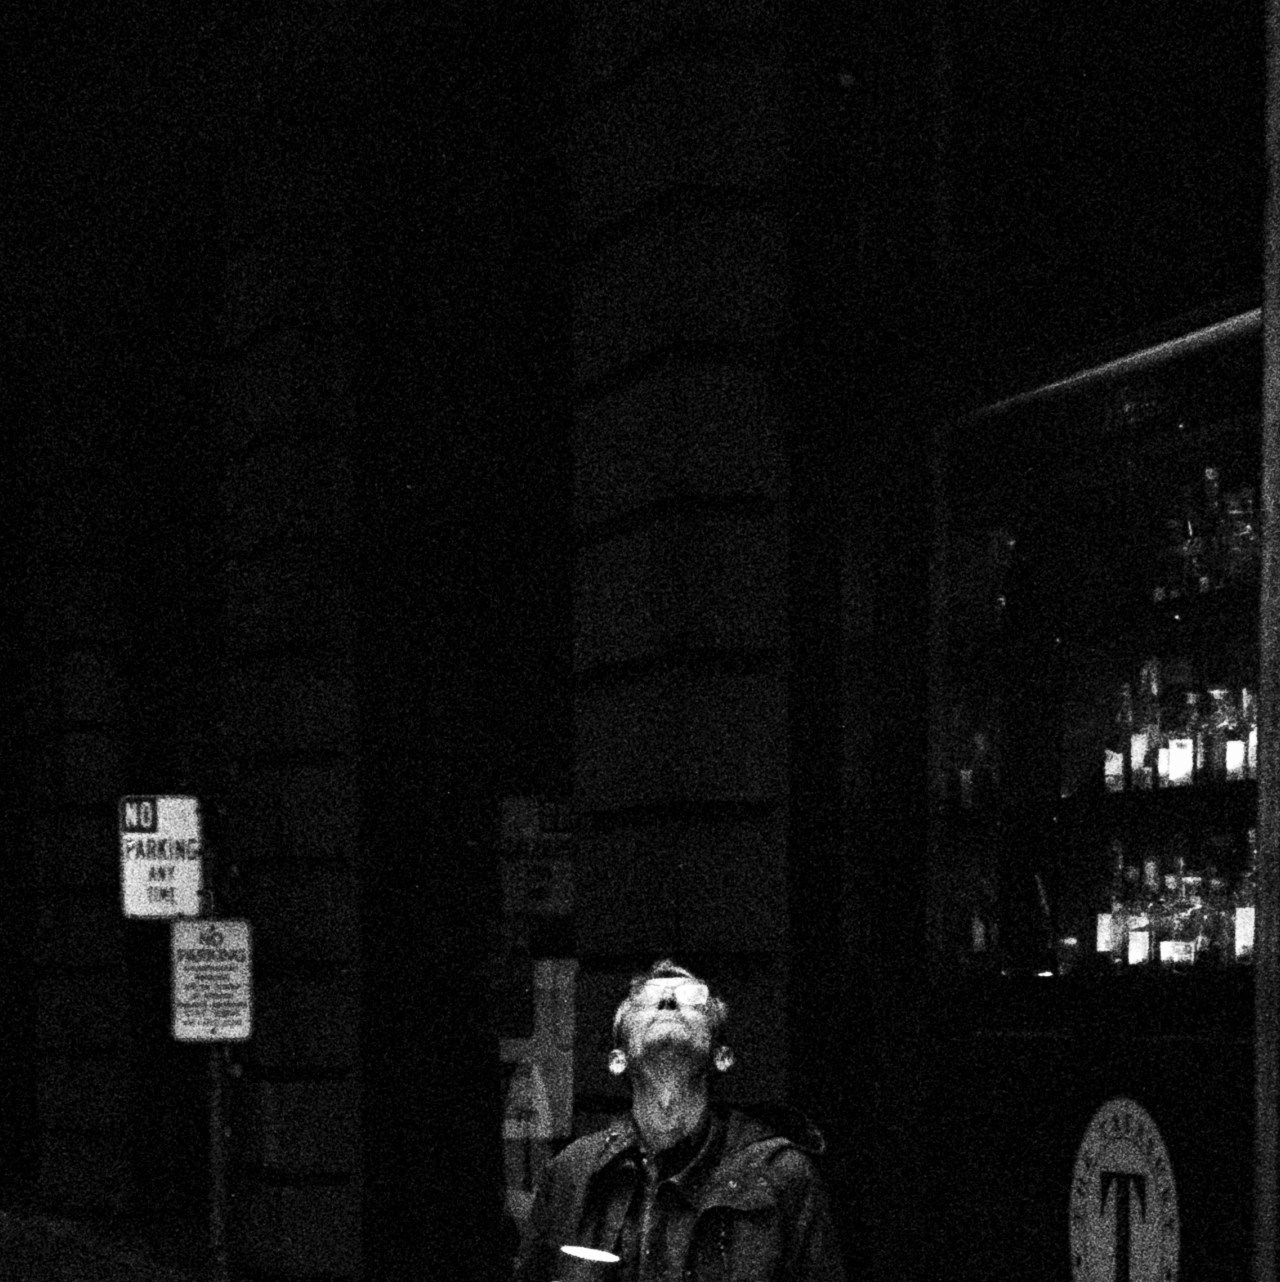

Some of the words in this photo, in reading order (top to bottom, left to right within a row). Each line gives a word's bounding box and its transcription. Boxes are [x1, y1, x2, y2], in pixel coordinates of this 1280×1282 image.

[125, 802, 153, 828] NO
[124, 838, 198, 860] PARKING
[148, 866, 175, 881] ANY
